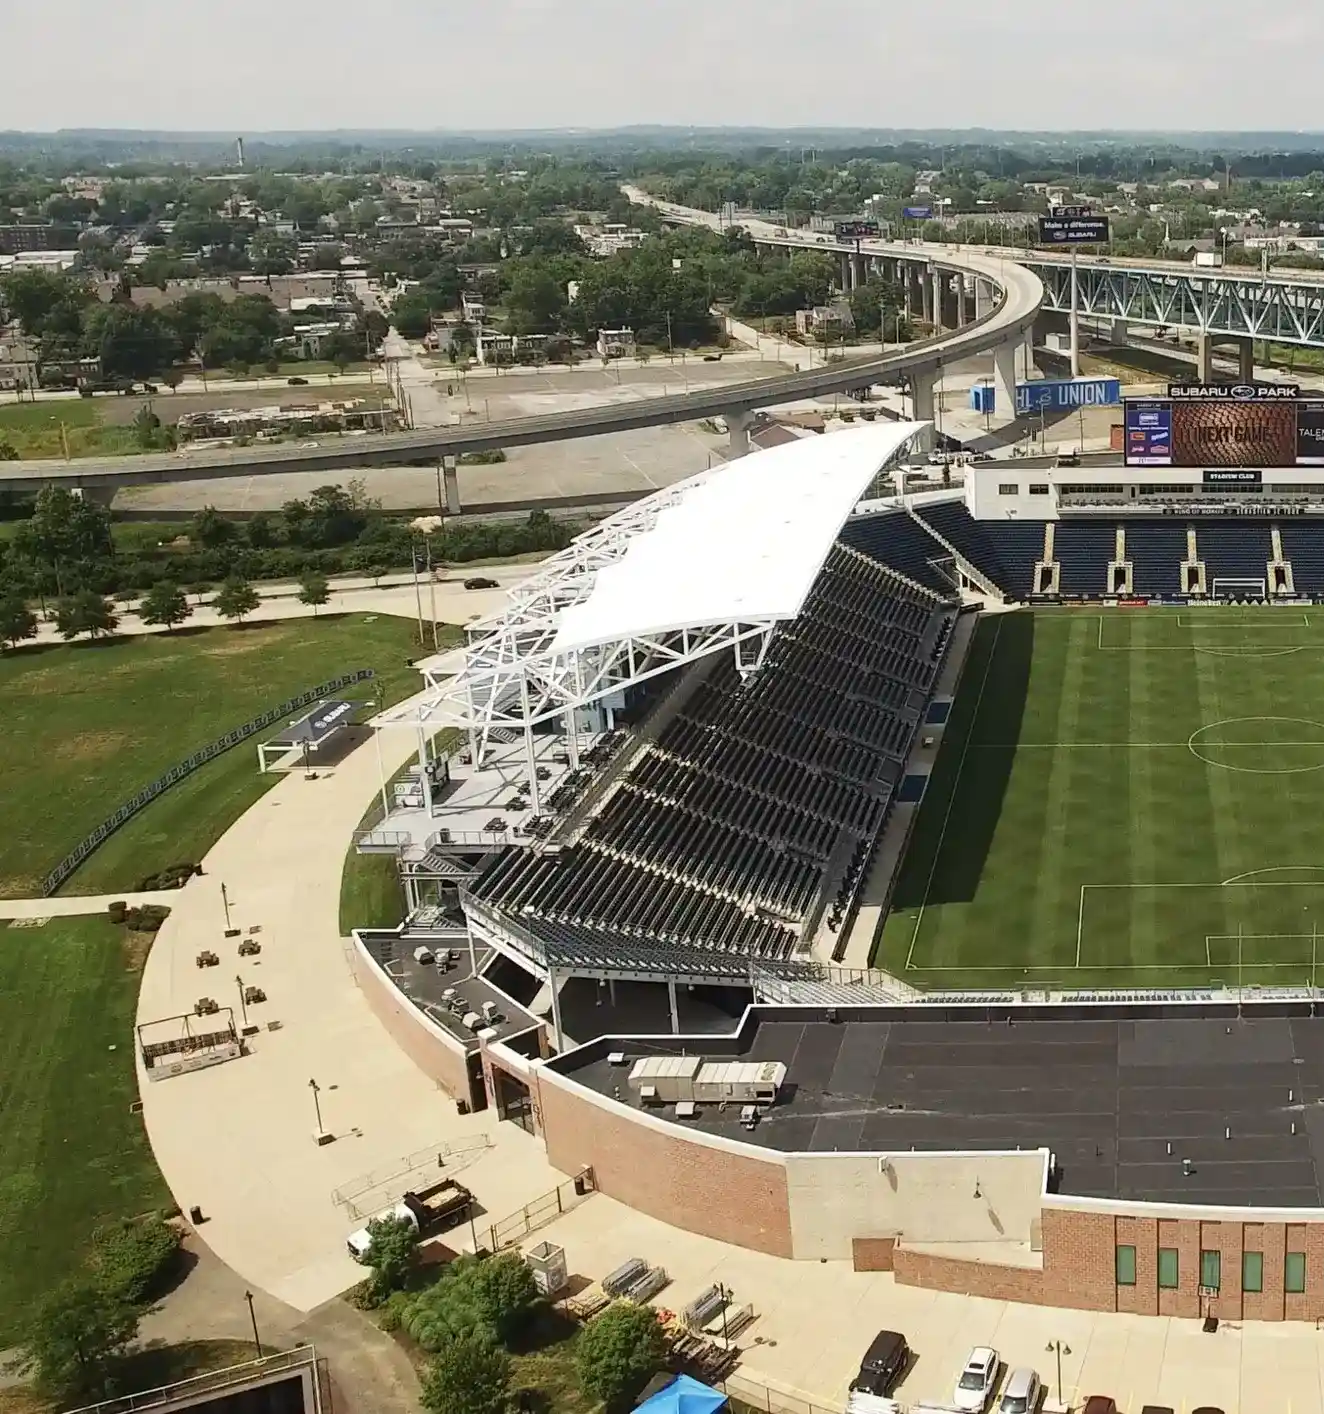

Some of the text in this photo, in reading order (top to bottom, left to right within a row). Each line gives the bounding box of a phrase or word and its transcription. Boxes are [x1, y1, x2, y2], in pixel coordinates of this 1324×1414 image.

[1058, 382, 1105, 405] UNION
[1171, 387, 1296, 397] SUBARU PARK
